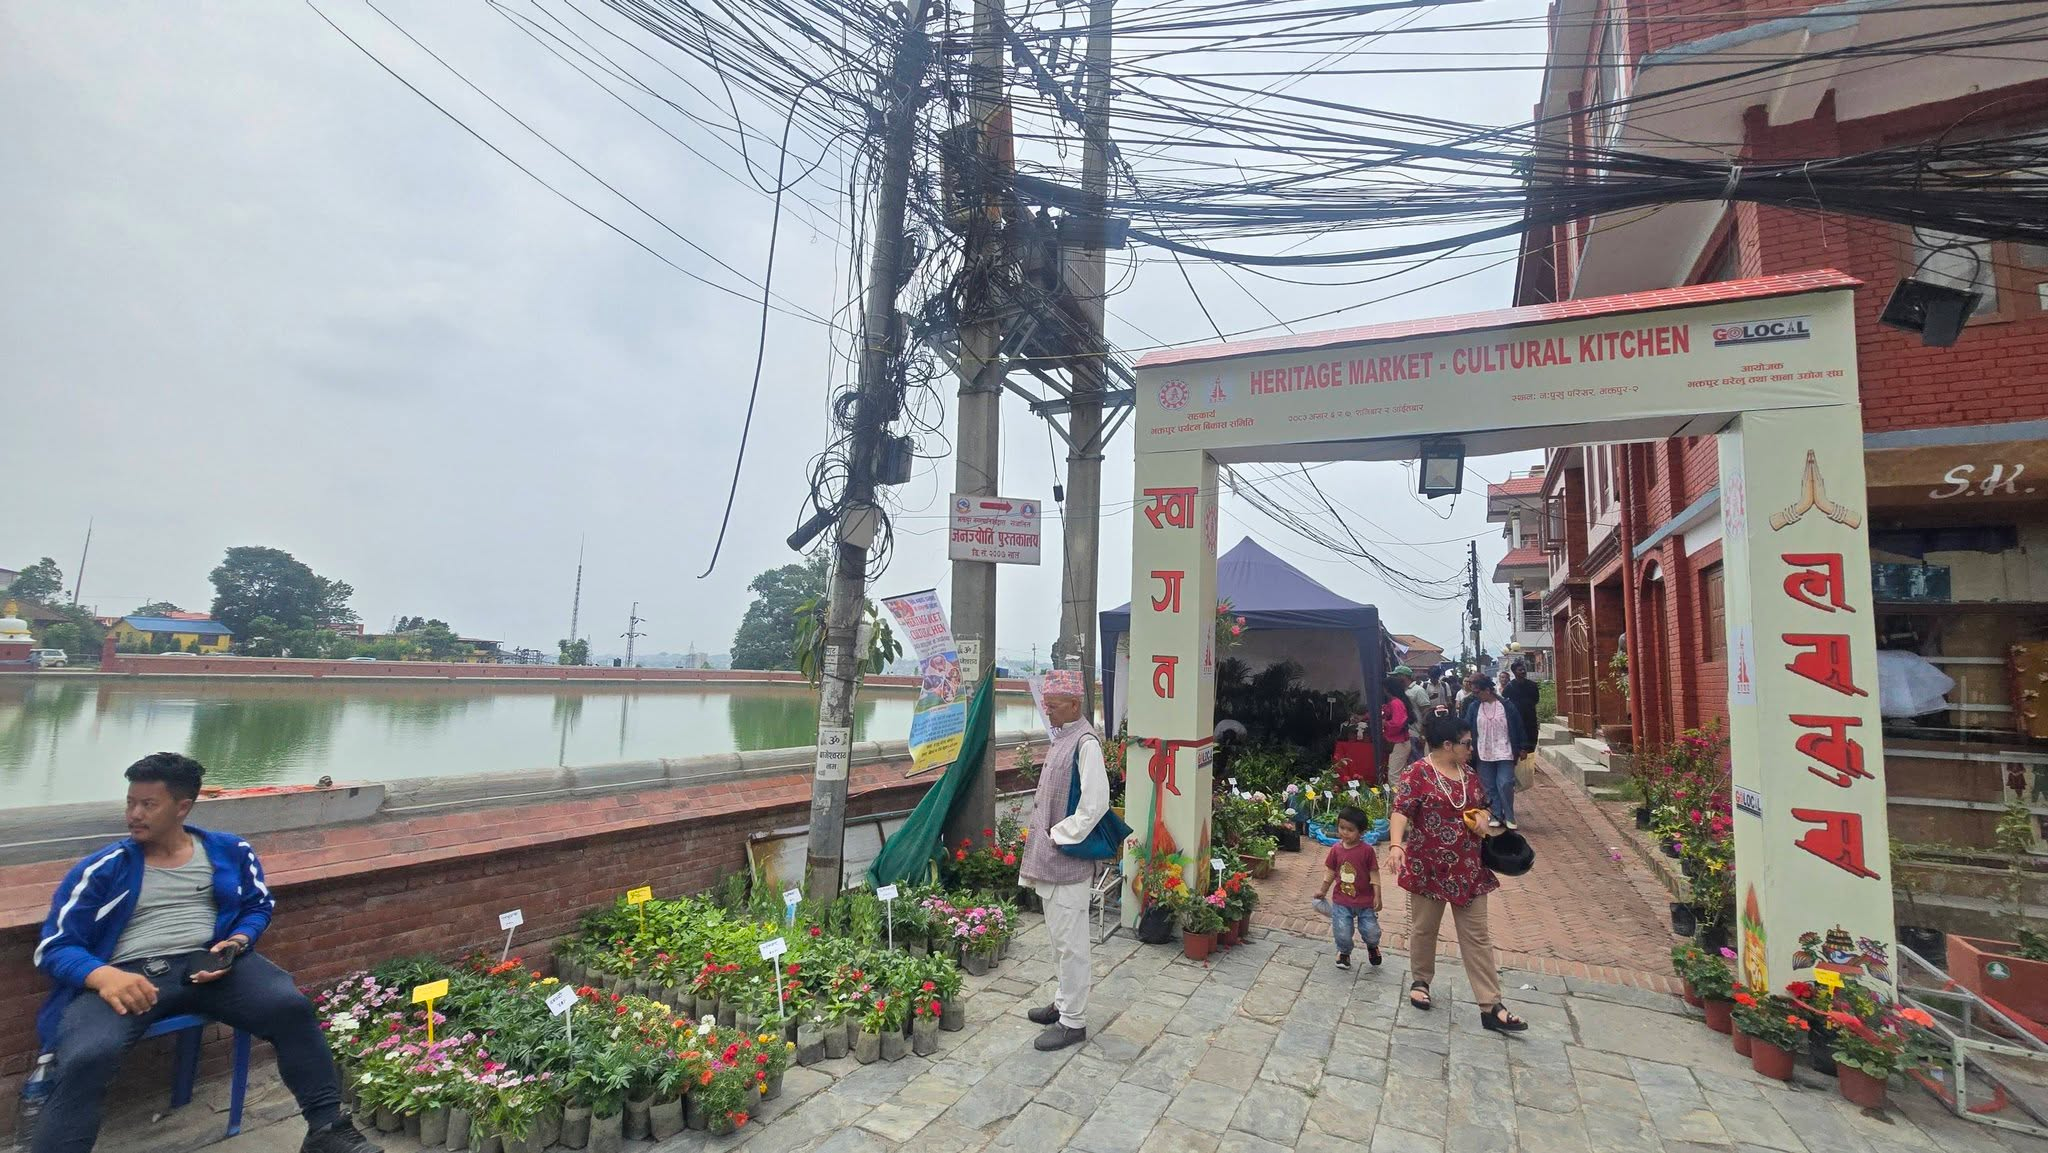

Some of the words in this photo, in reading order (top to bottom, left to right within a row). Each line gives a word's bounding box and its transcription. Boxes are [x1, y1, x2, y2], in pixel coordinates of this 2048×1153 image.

[1249, 361, 1343, 396] HERITAGE
[1349, 351, 1434, 386] MARKET
[1452, 336, 1572, 376] CULTURAL
[1579, 324, 1691, 363] KITCHEN
[1741, 362, 1784, 373] आयोजक
[1748, 375, 1767, 384] तथा
[1770, 373, 1793, 383] साना
[952, 527, 995, 545] जनज्योति
[998, 531, 1040, 548] पुस्तकालय
[828, 735, 841, 745] ॐ
